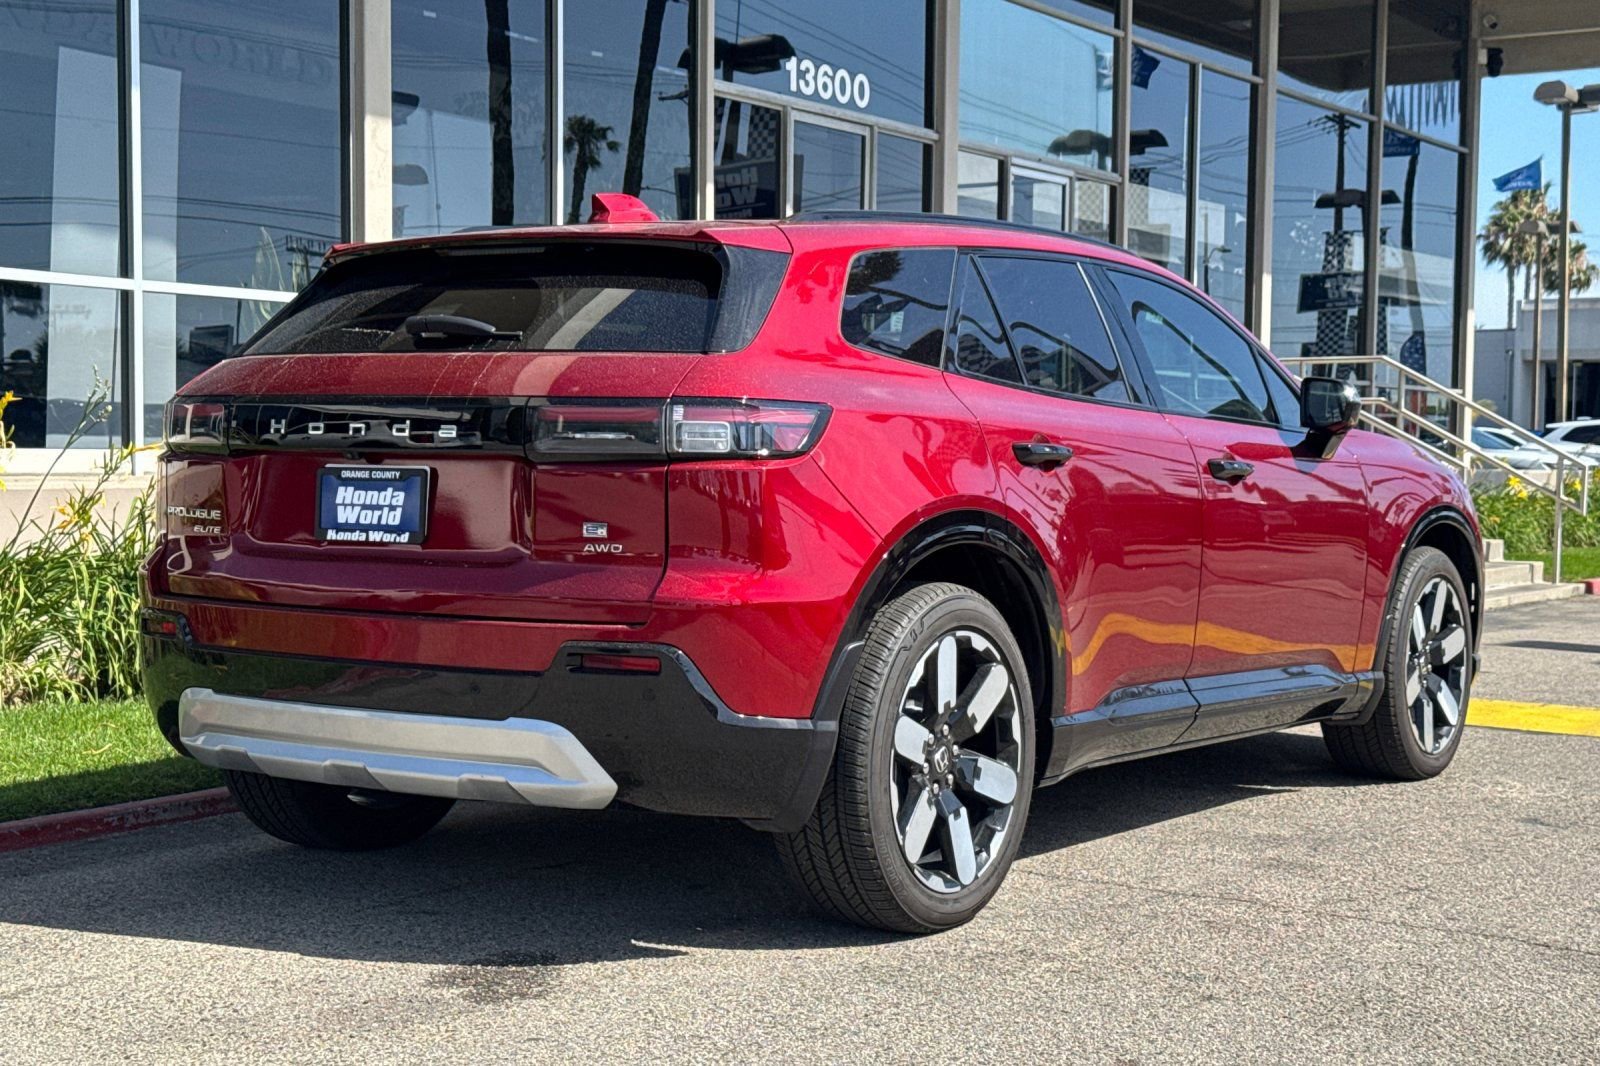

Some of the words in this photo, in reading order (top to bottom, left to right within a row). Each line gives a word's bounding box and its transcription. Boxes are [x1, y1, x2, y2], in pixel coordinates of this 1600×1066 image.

[786, 56, 869, 108] 13600
[341, 470, 369, 479] ORANGE
[371, 471, 400, 479] COUNTY
[335, 486, 405, 506] Honda
[167, 506, 221, 520] PROLOGUE
[337, 505, 402, 525] World
[193, 525, 221, 533] ELITE
[326, 529, 366, 541] Honda
[583, 543, 622, 552] AWD
